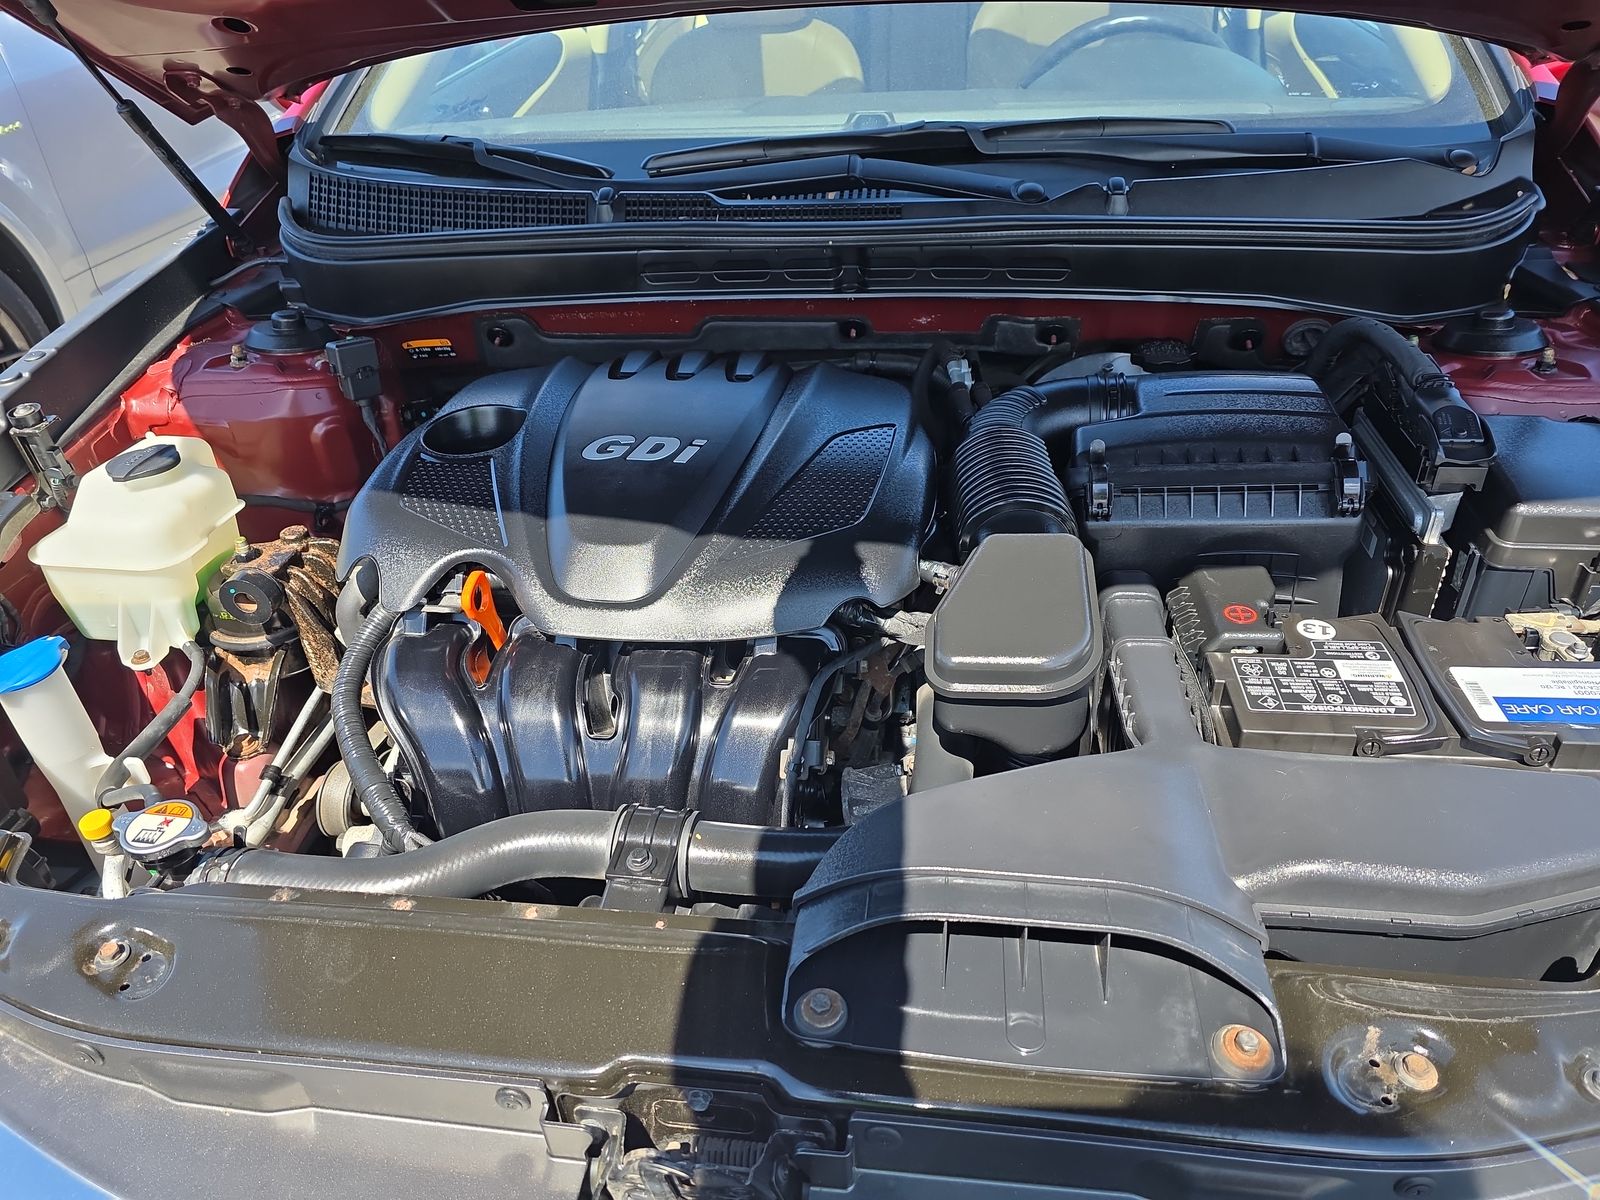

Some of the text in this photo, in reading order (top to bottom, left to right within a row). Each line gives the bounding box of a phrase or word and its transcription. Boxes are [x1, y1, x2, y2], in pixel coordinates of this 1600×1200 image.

[581, 435, 708, 464] GDi
[1302, 623, 1330, 636] 13
[1502, 703, 1598, 716] CAR CARE
